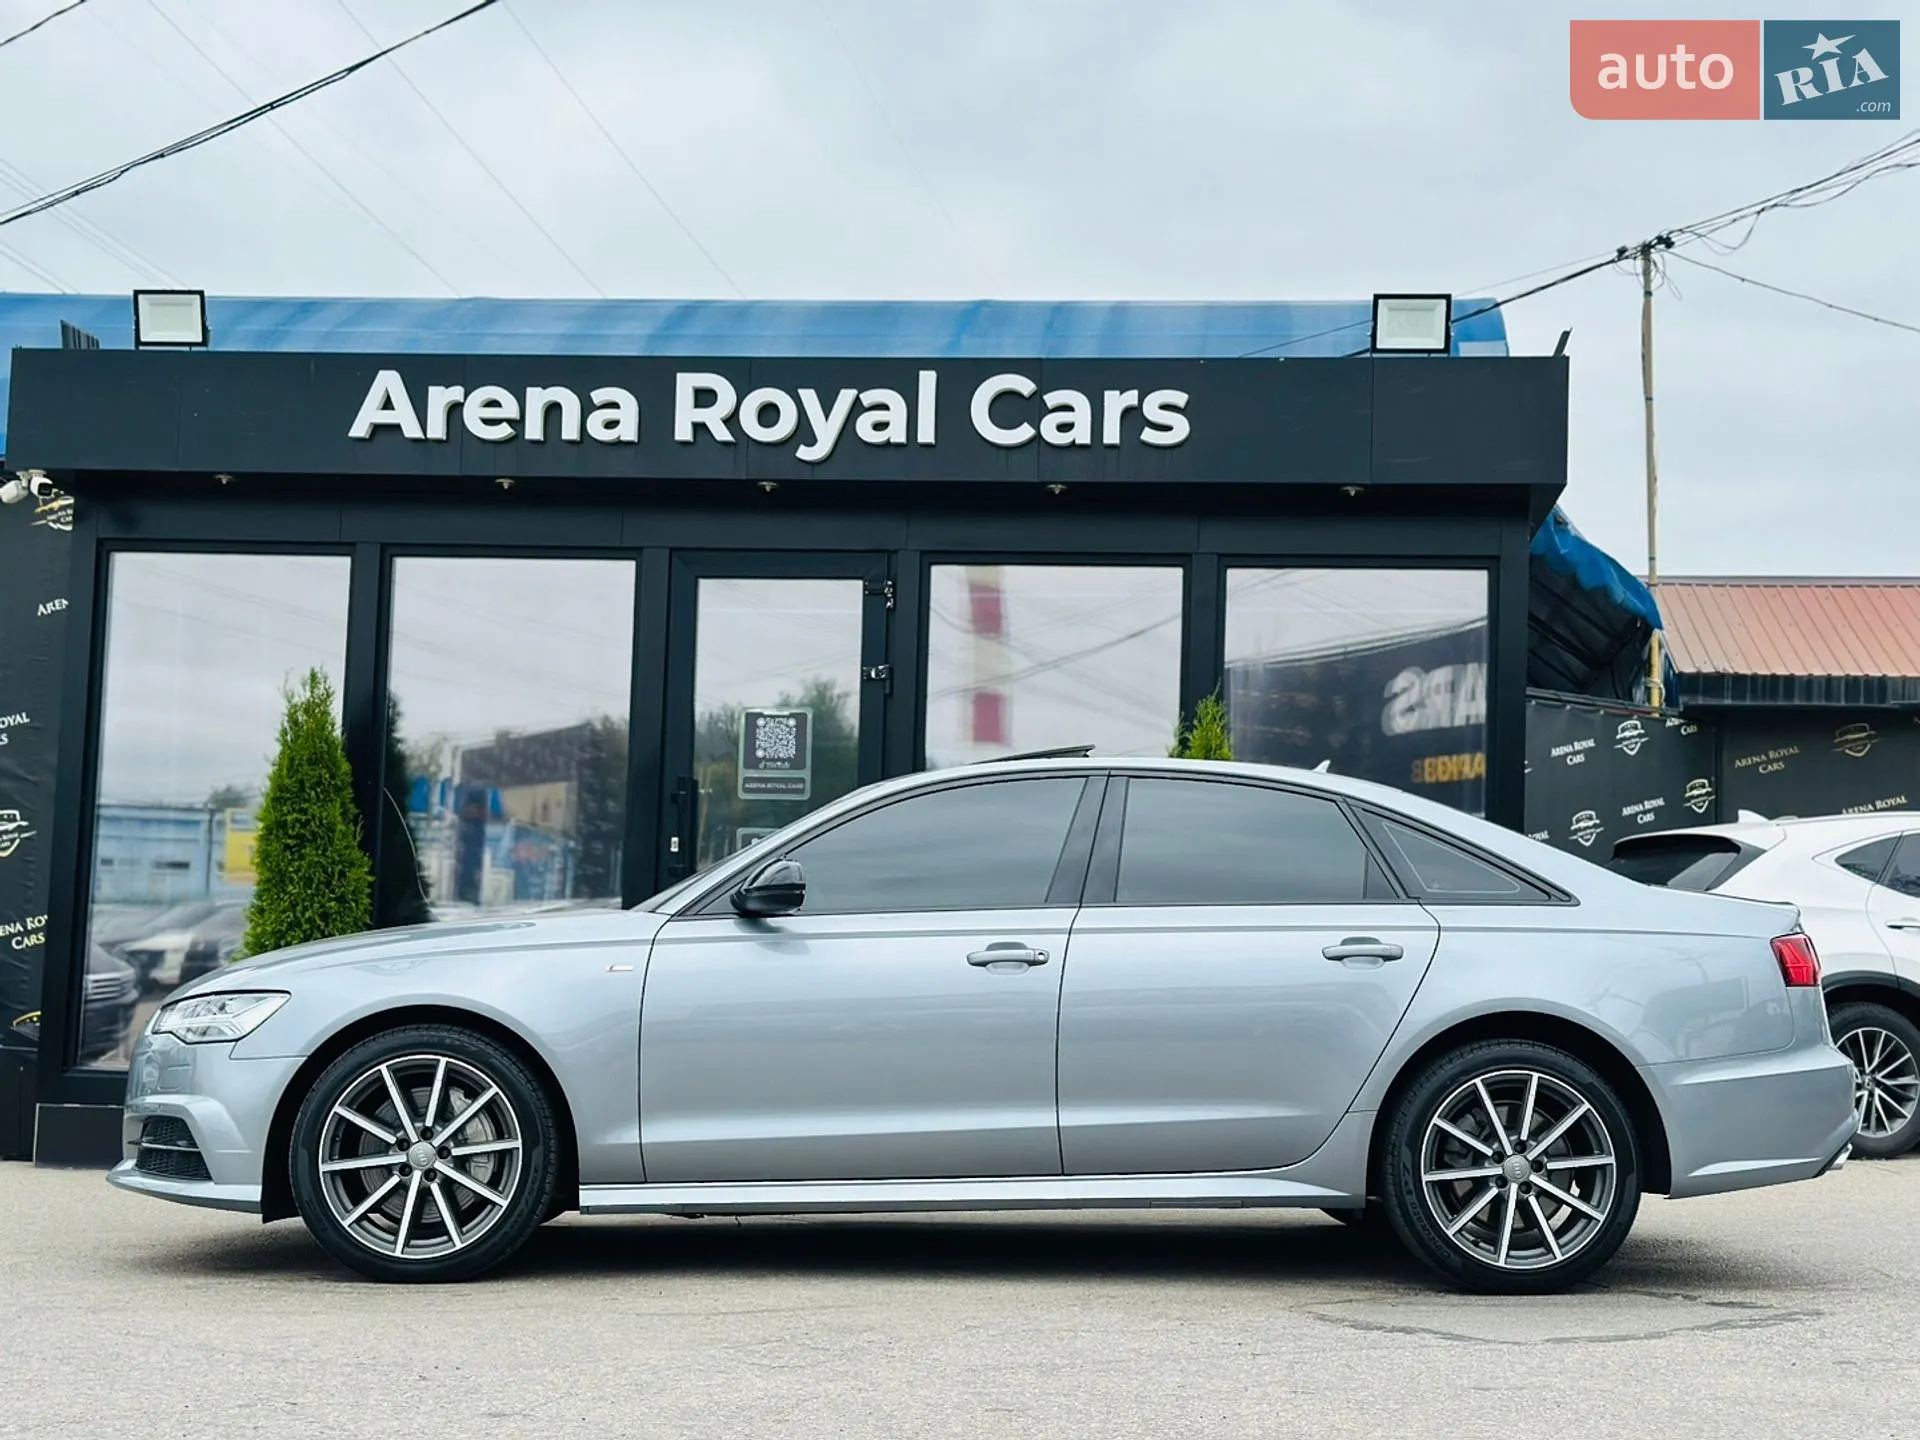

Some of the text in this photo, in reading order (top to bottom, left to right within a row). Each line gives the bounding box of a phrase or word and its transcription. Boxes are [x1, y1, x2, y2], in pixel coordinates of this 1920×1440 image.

[348, 370, 1190, 463] Arena Royal Cars
[1550, 738, 1596, 757] ARENA ROYAL
[1566, 753, 1586, 766] CARS
[1734, 745, 1800, 769] ARENA ROYAL
[1758, 760, 1785, 774] CARS
[1621, 797, 1665, 817] ARENA ROYAL
[1874, 795, 1907, 810] ROYAL
[1636, 812, 1655, 825] CARS
[11, 932, 46, 950] CARS
